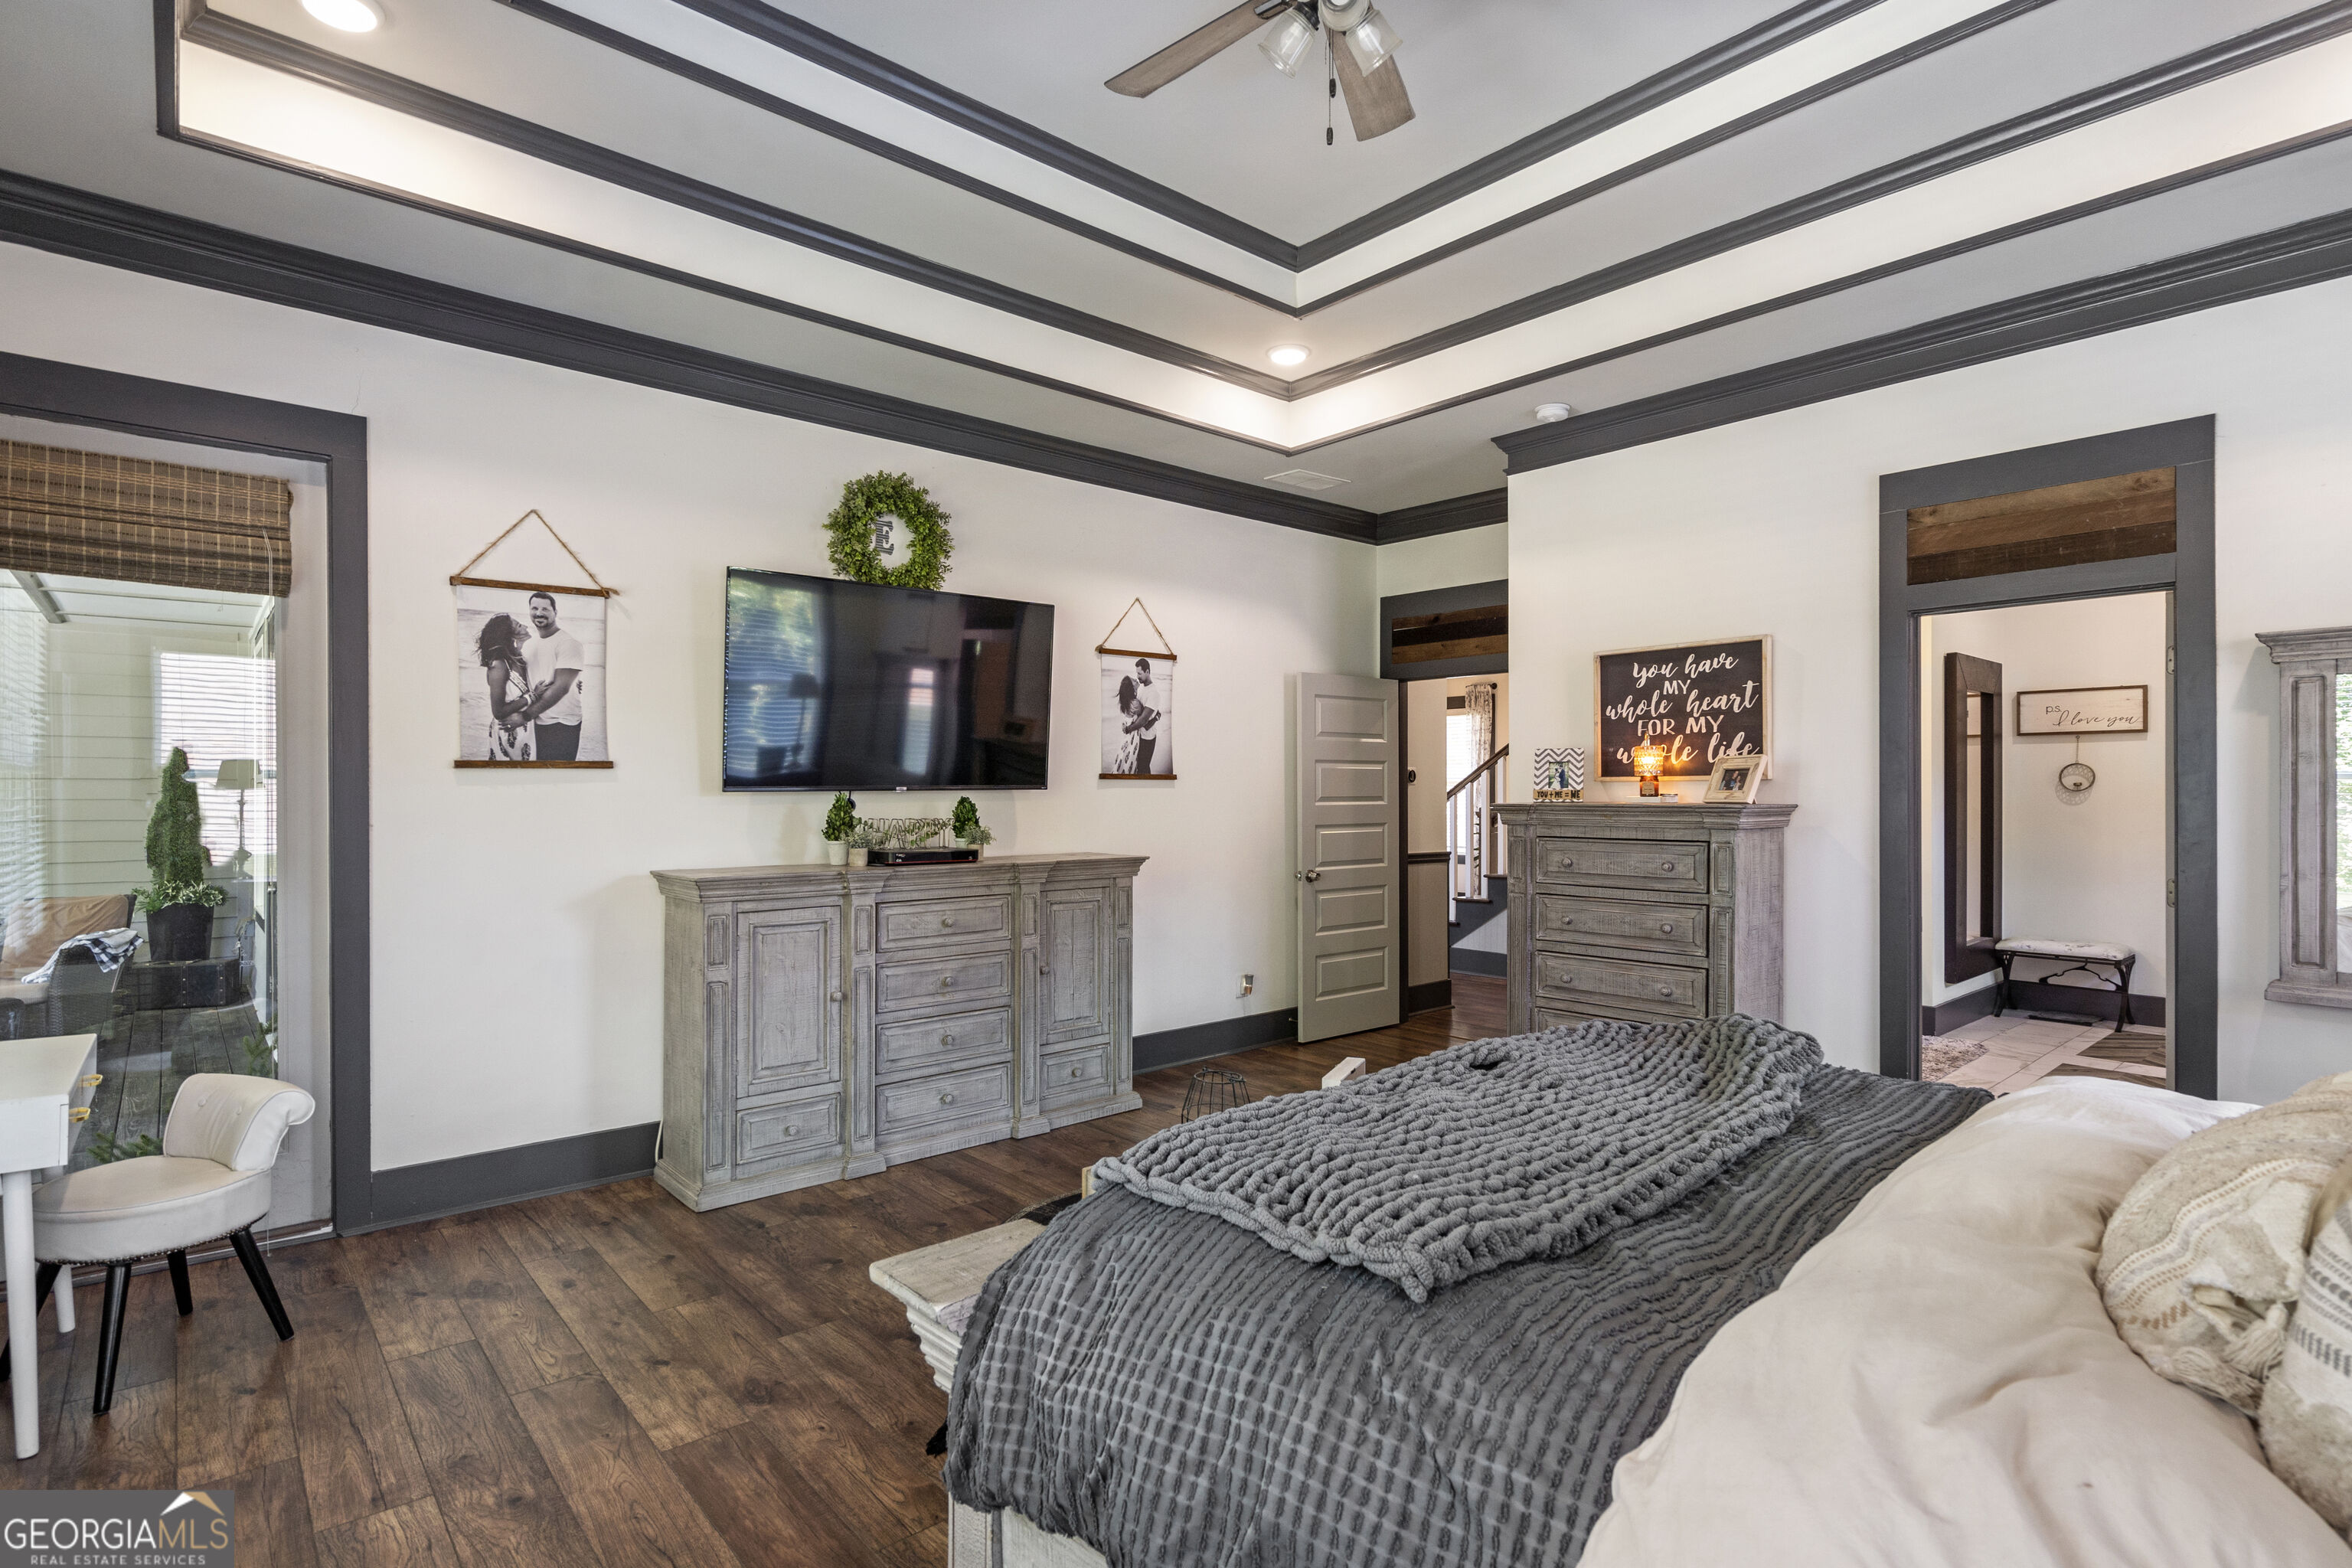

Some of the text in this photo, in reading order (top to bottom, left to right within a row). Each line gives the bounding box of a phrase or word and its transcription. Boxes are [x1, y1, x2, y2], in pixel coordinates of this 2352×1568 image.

[1632, 652, 1739, 688] you have
[1663, 679, 1691, 694] MY
[1606, 680, 1760, 723] whole heart
[1637, 714, 1724, 737] FOR MY
[2070, 712, 2105, 726] love
[2107, 715, 2140, 727] you
